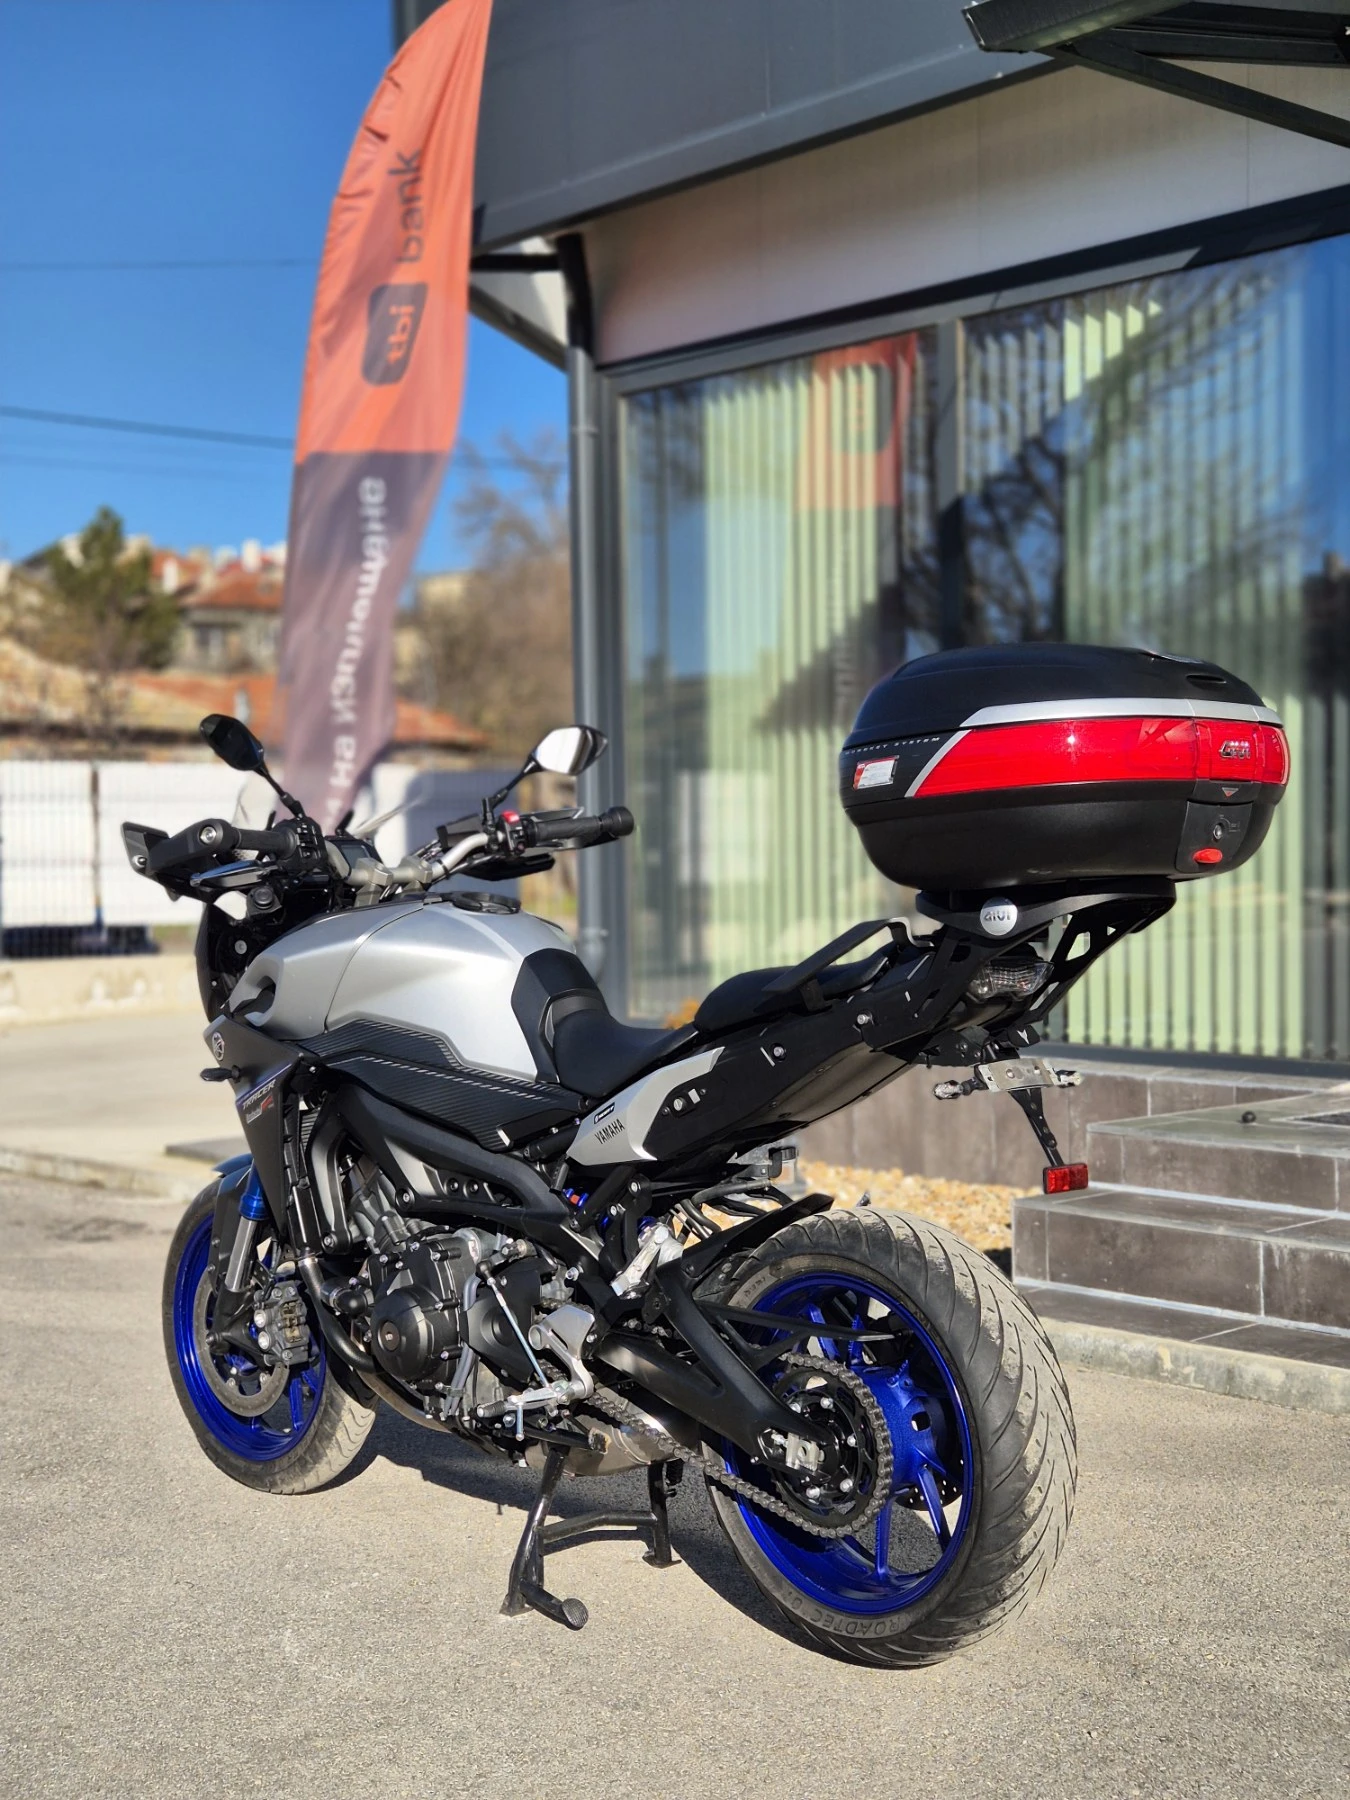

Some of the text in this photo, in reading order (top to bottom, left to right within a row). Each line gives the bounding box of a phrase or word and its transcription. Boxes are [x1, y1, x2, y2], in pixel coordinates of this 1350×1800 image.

[386, 149, 425, 365] tbi bank
[330, 476, 389, 724] изплащане
[894, 737, 940, 747] SYSTEM
[329, 734, 356, 788] на
[984, 910, 1011, 922] GIVI
[242, 1079, 276, 1110] TRACER
[594, 1118, 625, 1144] YAMAHA
[809, 1607, 901, 1636] ROADTEC
